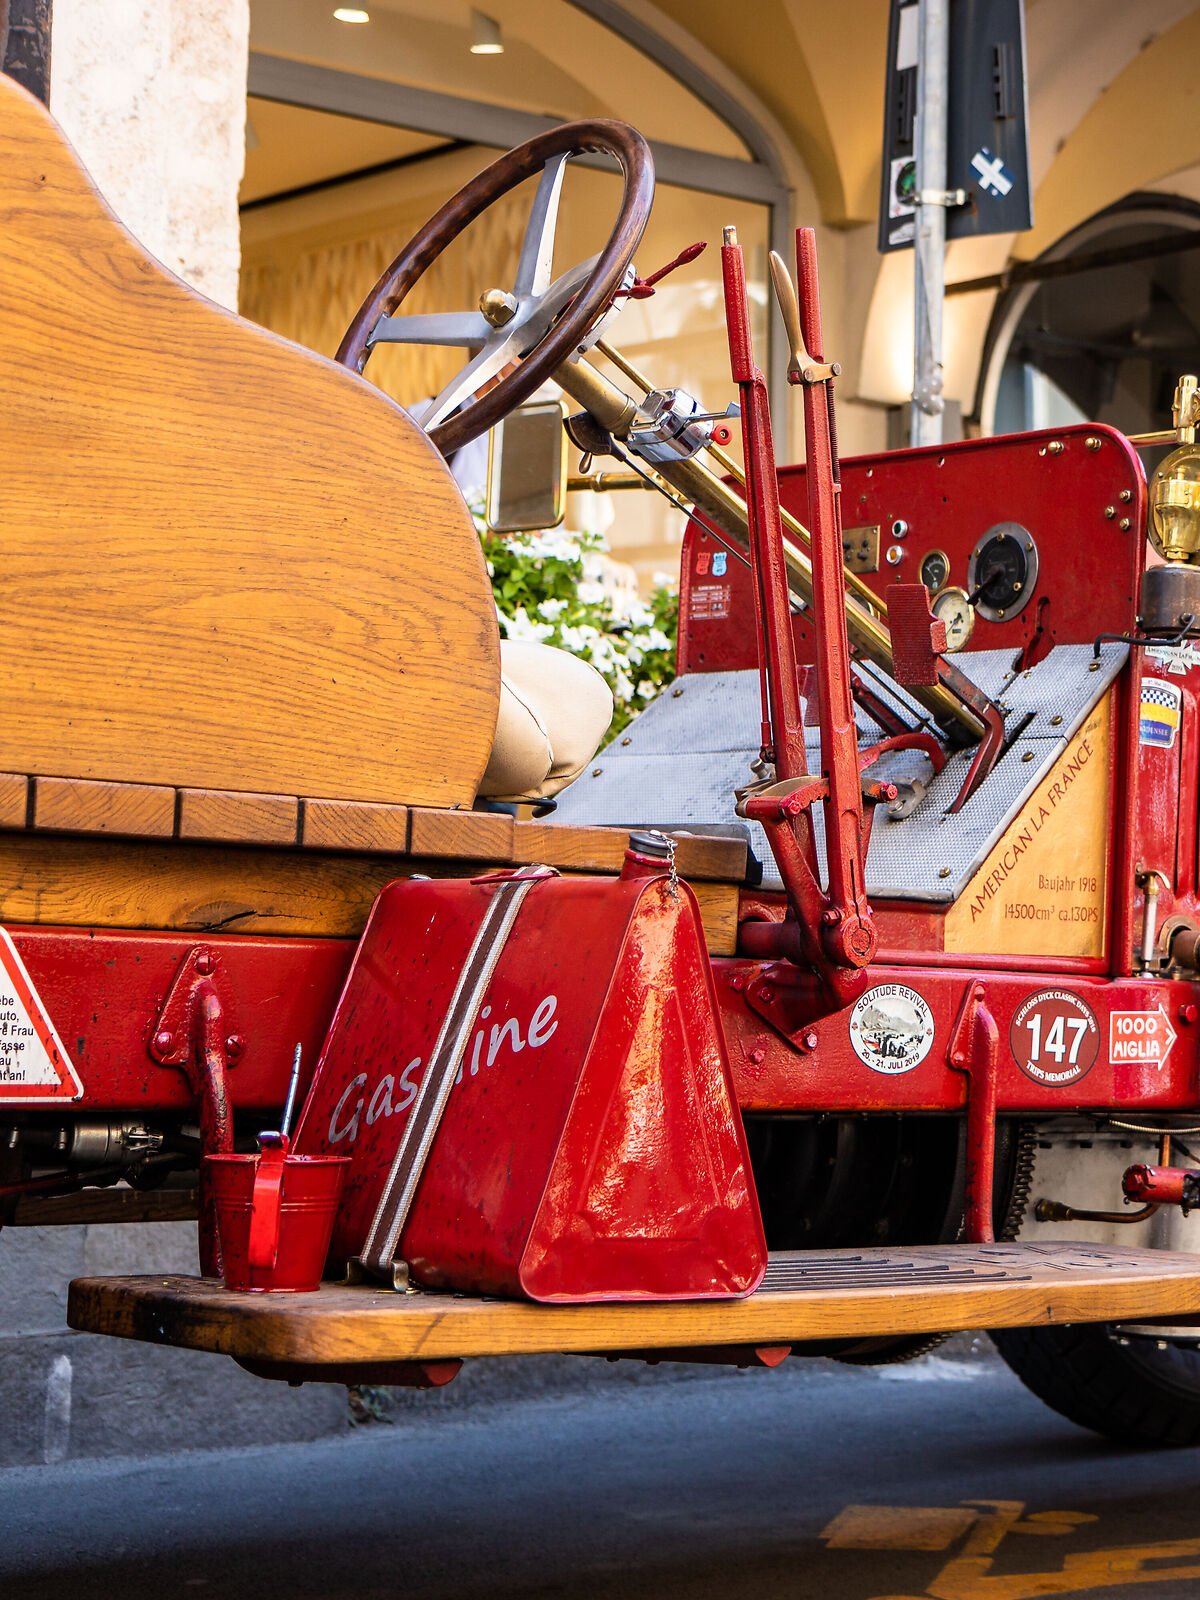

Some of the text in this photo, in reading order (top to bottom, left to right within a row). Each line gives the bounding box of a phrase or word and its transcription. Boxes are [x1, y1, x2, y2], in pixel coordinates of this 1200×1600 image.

[968, 827, 1033, 923] AMERICAN
[1030, 806, 1050, 833] LA
[1047, 739, 1094, 808] FRANCE
[1038, 874, 1097, 893] Baujahr 1918
[0, 994, 14, 1006] be
[857, 985, 928, 1018] SOLITUDE REVIVAL
[1015, 996, 1039, 1027] SCHLOSS
[1054, 991, 1078, 1006] CLASSIC
[1076, 1000, 1090, 1018] DAYS
[11, 1024, 34, 1036] Frau
[1116, 1017, 1157, 1035] 1000
[1026, 1013, 1088, 1065] 147
[1113, 1040, 1160, 1058] MIGLIA
[861, 1048, 871, 1062] 20.
[876, 1059, 886, 1069] 21.
[887, 1061, 903, 1069] JULI
[904, 1052, 920, 1067] 2019
[9, 1070, 26, 1081] an!
[328, 995, 559, 1144] Gasine
[1026, 1060, 1082, 1082] TRIPS MEMORIAL
